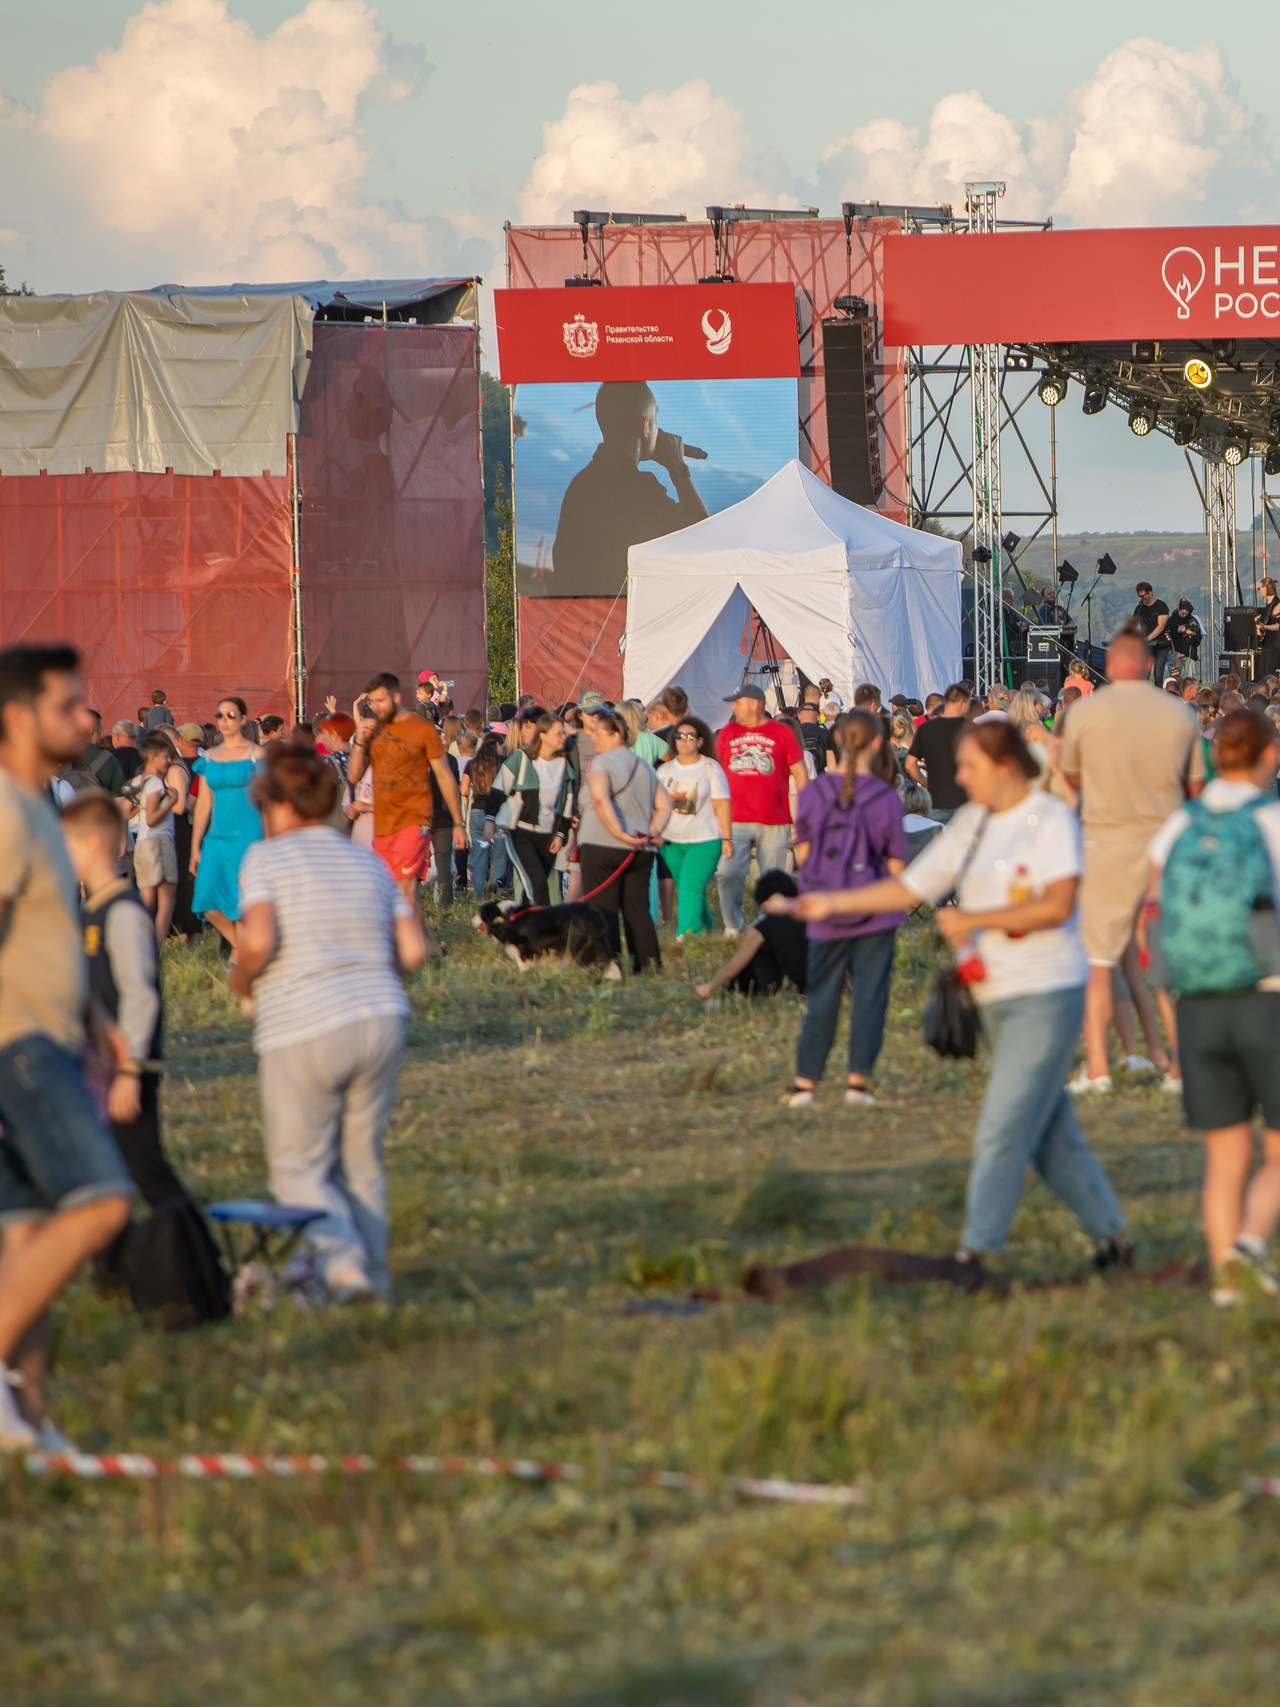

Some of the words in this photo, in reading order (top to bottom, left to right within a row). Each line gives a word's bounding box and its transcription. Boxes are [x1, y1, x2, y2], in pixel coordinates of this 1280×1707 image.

[604, 324, 660, 334] Правительство
[605, 334, 643, 344] Рязанской
[643, 333, 674, 343] области
